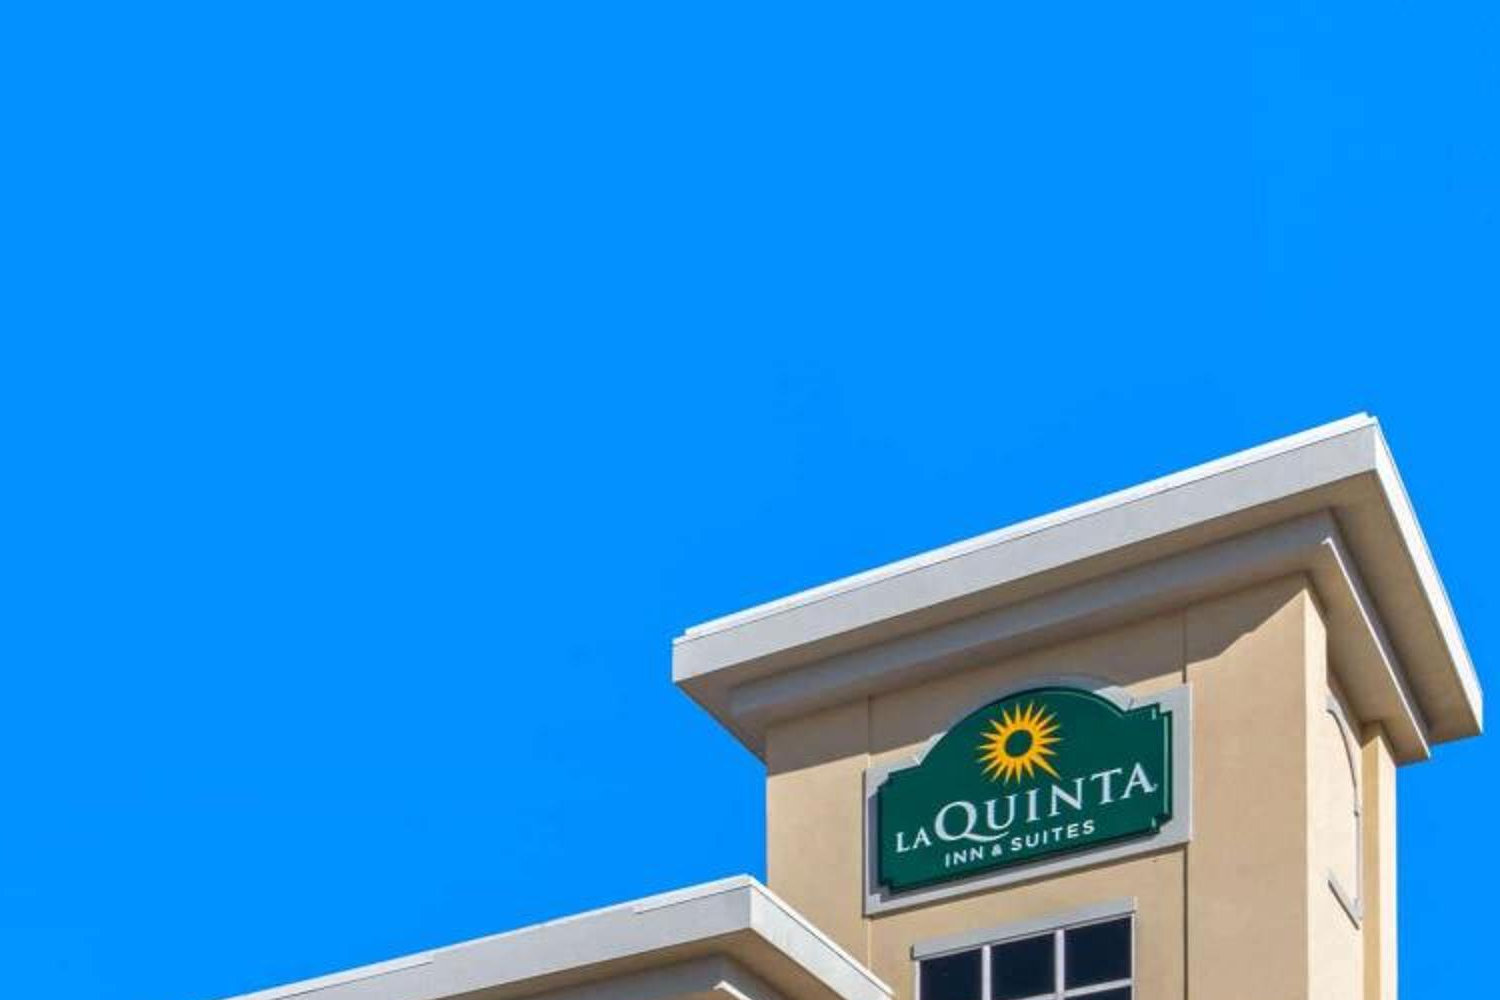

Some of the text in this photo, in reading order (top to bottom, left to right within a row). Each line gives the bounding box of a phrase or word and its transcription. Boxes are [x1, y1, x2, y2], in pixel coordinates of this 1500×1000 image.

[896, 762, 1158, 853] LA QUINTA
[944, 819, 1095, 868] INN & SUITES
